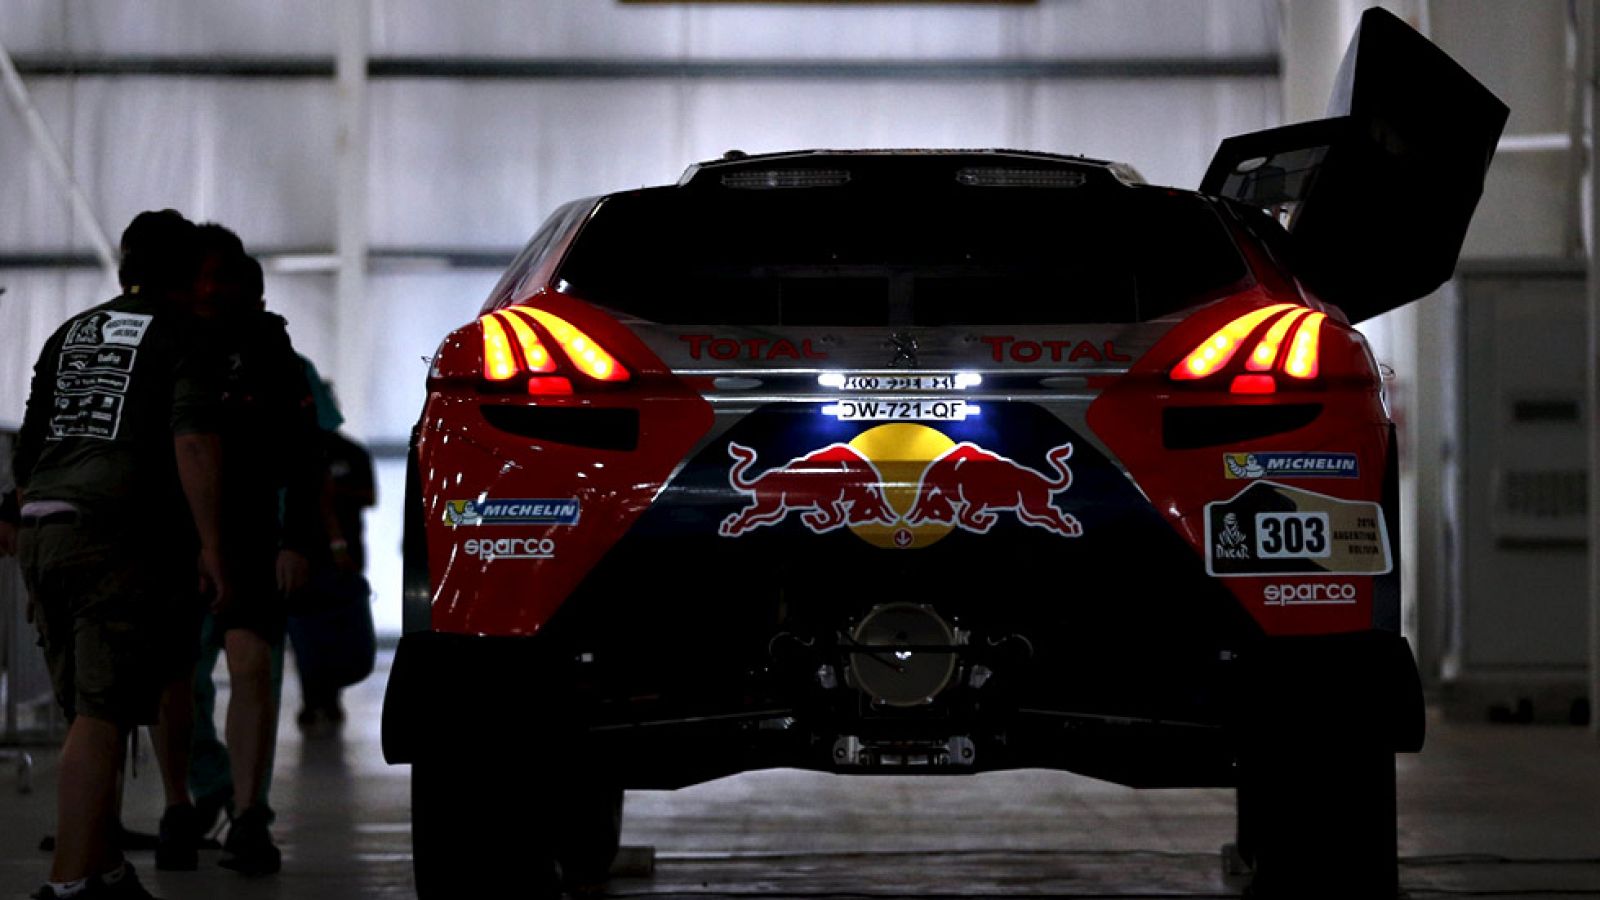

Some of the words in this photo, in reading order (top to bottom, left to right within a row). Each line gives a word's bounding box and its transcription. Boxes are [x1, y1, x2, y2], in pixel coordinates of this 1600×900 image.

[679, 334, 828, 361] TOTAL
[980, 335, 1132, 363] TOTAL
[1267, 457, 1355, 471] MICHELIN
[483, 504, 575, 517] MICHELIN
[1262, 517, 1325, 554] 303
[464, 538, 555, 560] sparco
[1263, 583, 1356, 606] sparco
